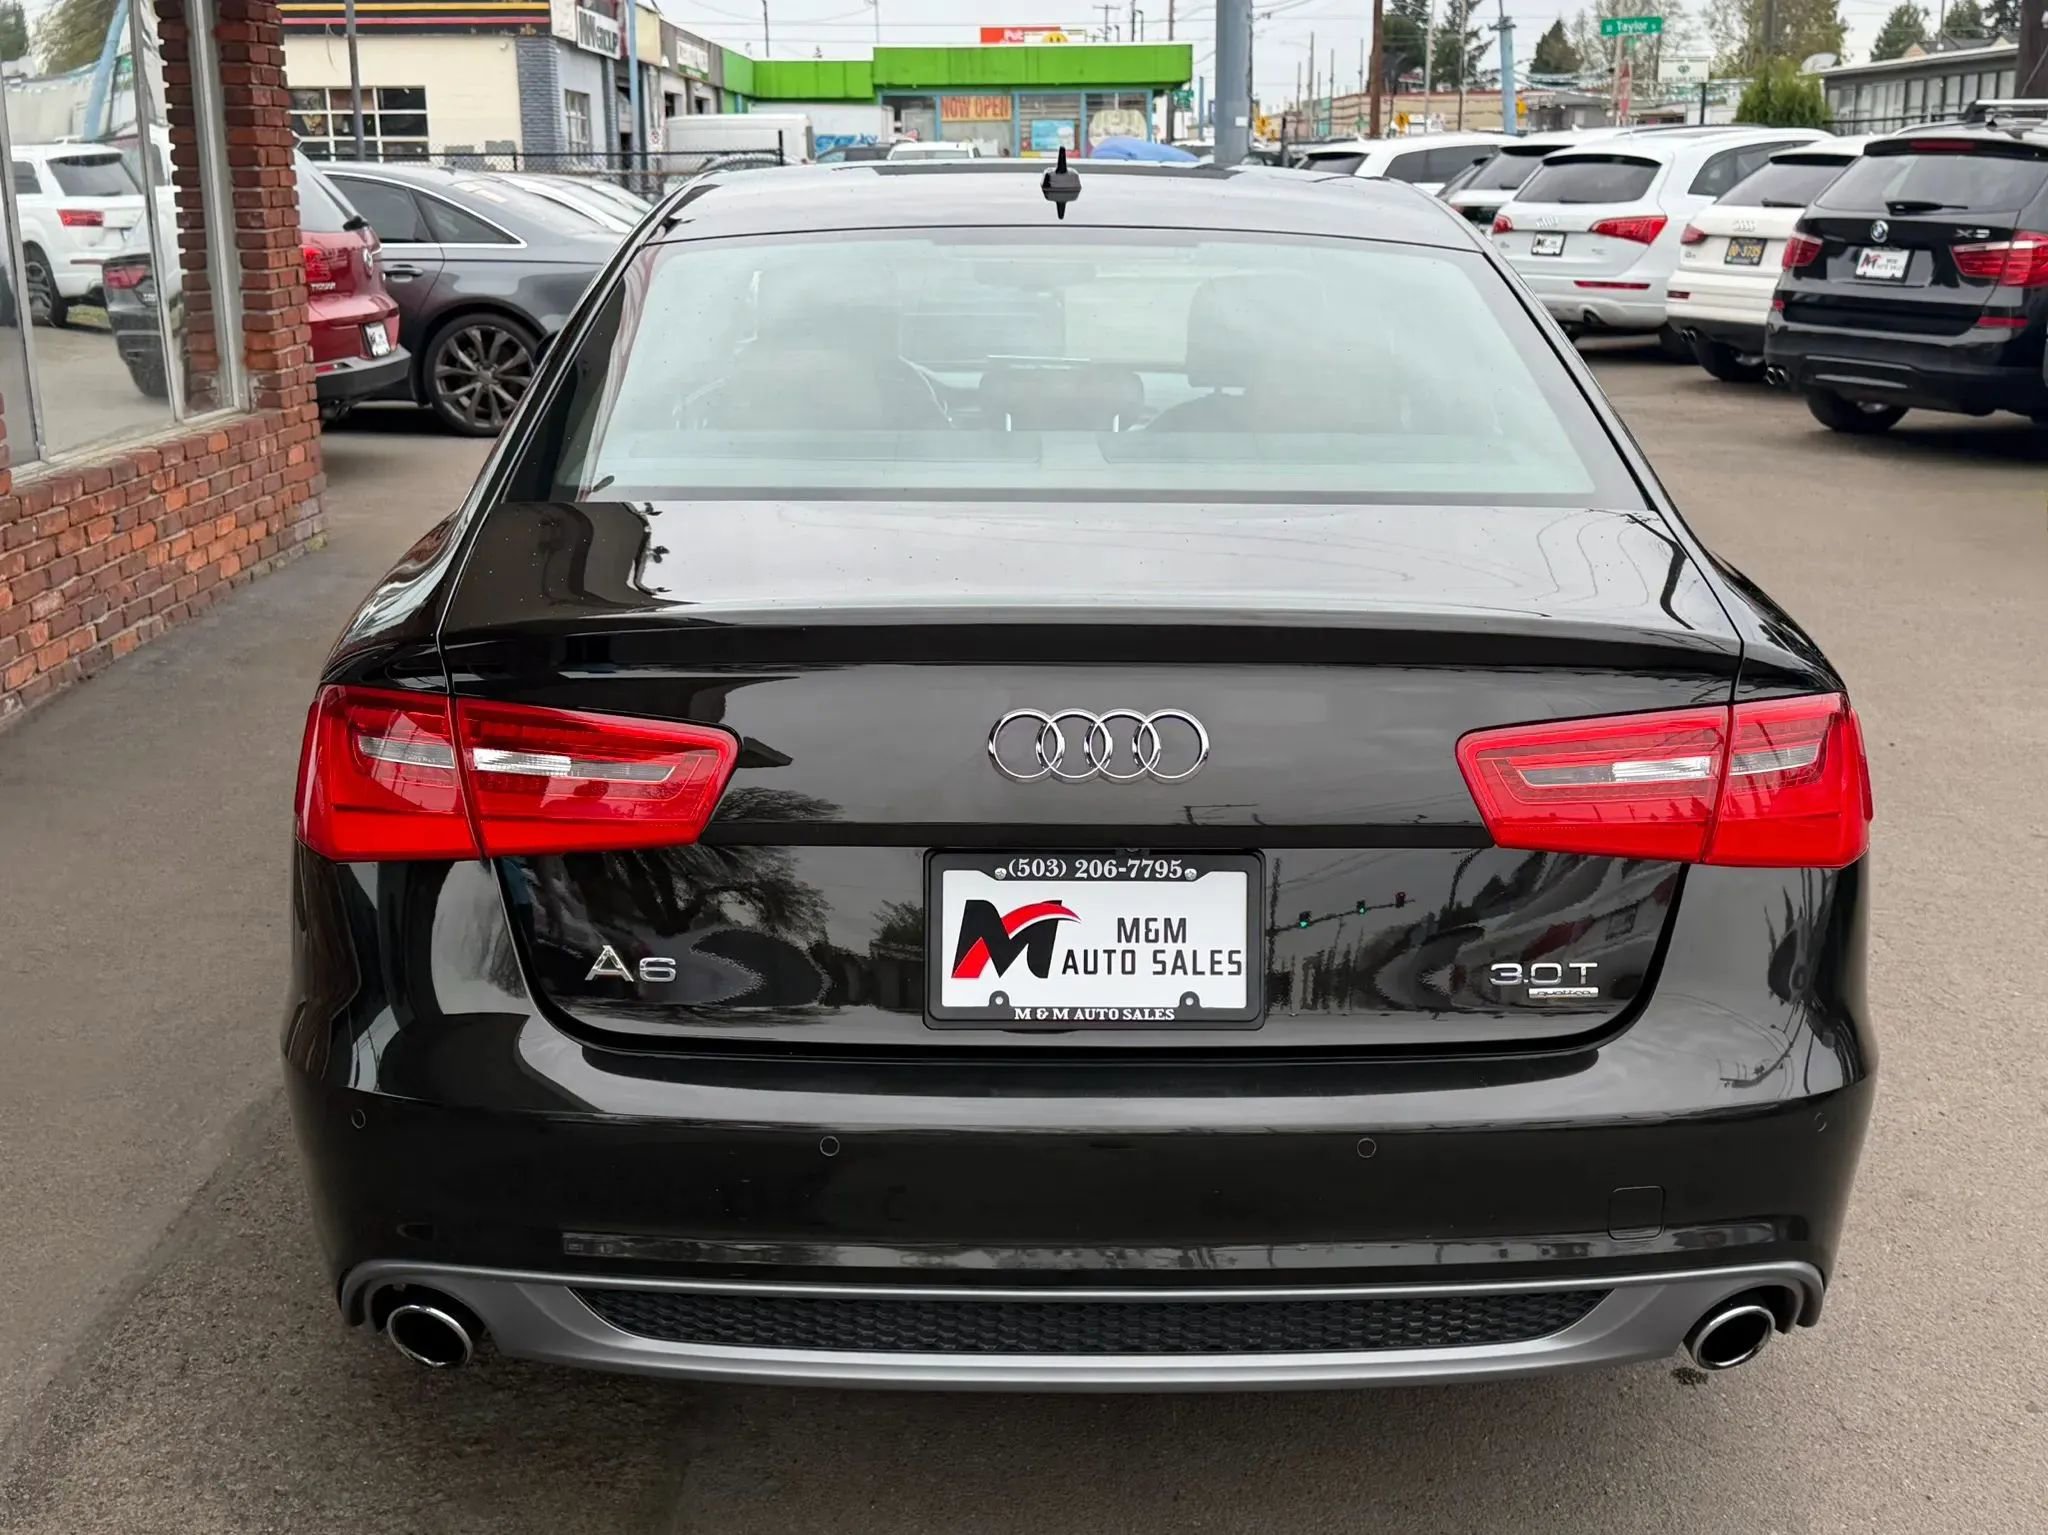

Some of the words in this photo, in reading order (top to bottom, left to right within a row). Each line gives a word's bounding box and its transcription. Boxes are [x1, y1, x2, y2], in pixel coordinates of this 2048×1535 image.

[1616, 20, 1648, 33] Taylor
[942, 97, 969, 118] NOW
[975, 96, 1009, 118] OPEN
[1008, 858, 1067, 878] (503)
[1074, 858, 1183, 880] 206-7795
[1117, 917, 1187, 944] M&M
[584, 944, 677, 983] A6
[1061, 949, 1136, 976] AUTO
[1152, 949, 1243, 976] SALES
[1489, 962, 1598, 986] 3.0T
[1014, 1008, 1032, 1020] M
[1036, 1008, 1049, 1020] &
[1052, 1008, 1070, 1020] M
[1074, 1008, 1119, 1020] AUTO
[1122, 1008, 1175, 1020] SALES
